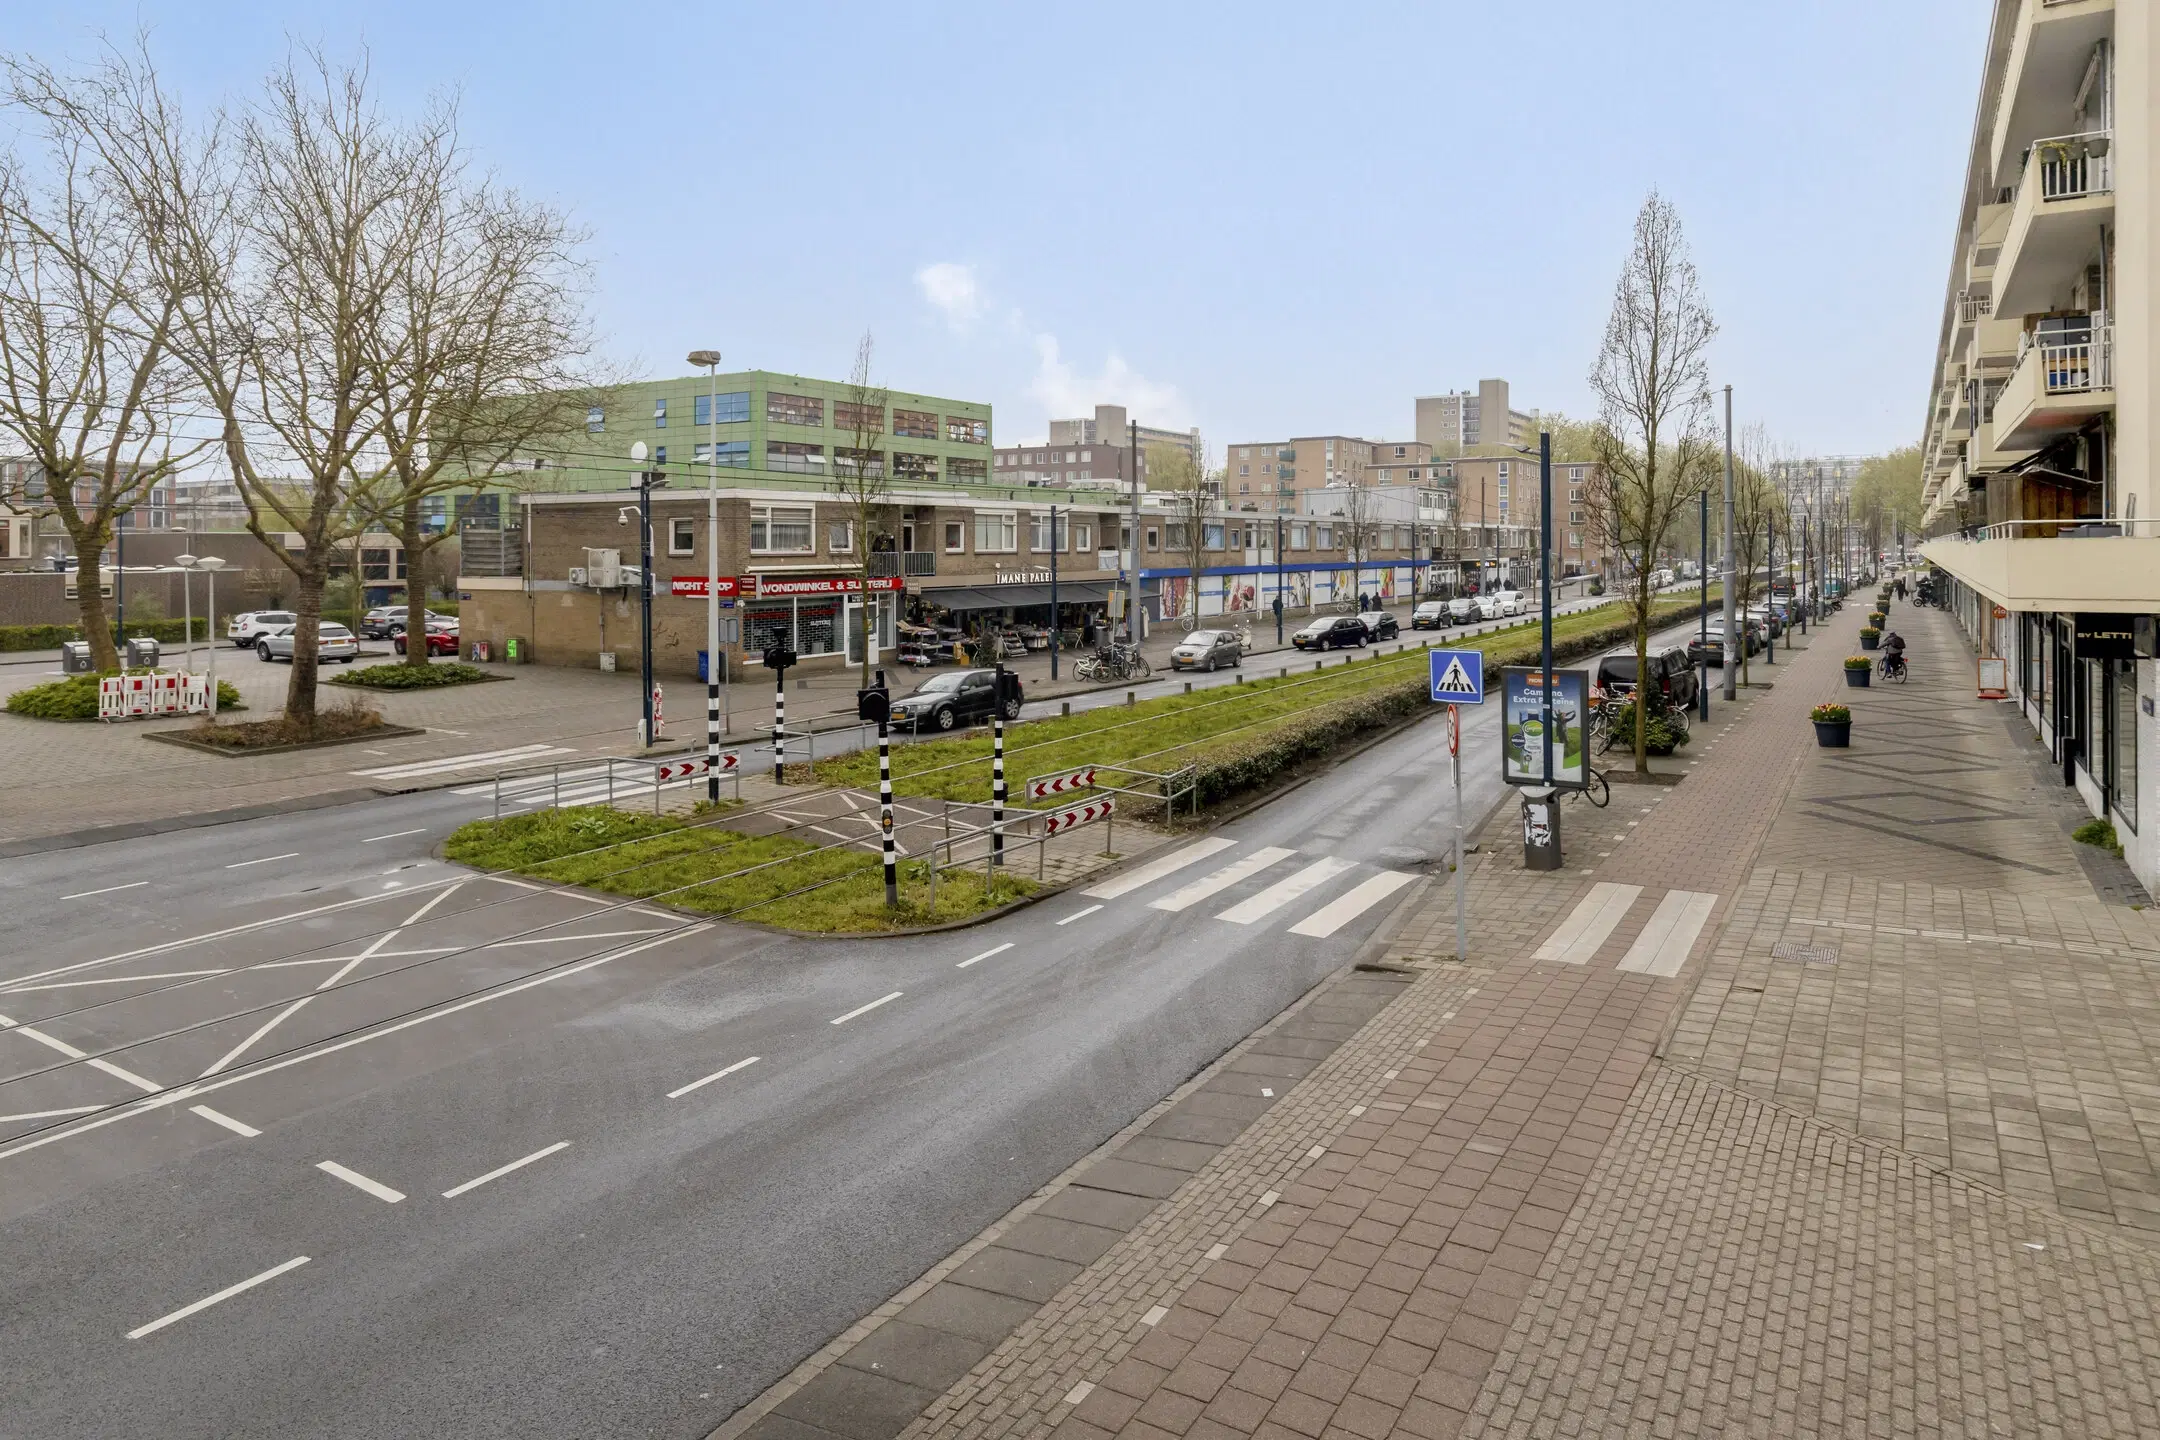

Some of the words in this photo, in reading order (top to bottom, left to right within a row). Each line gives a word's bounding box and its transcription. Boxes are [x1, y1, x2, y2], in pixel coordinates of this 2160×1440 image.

[1030, 572, 1057, 583] PALEI
[672, 581, 703, 591] NIGHT
[704, 582, 733, 591] SOP
[761, 582, 834, 593] AVONDWINKEL
[836, 581, 844, 590] &
[846, 579, 892, 590] SLITERIJ
[2094, 631, 2132, 639] LETTI
[1524, 688, 1563, 696] Camna
